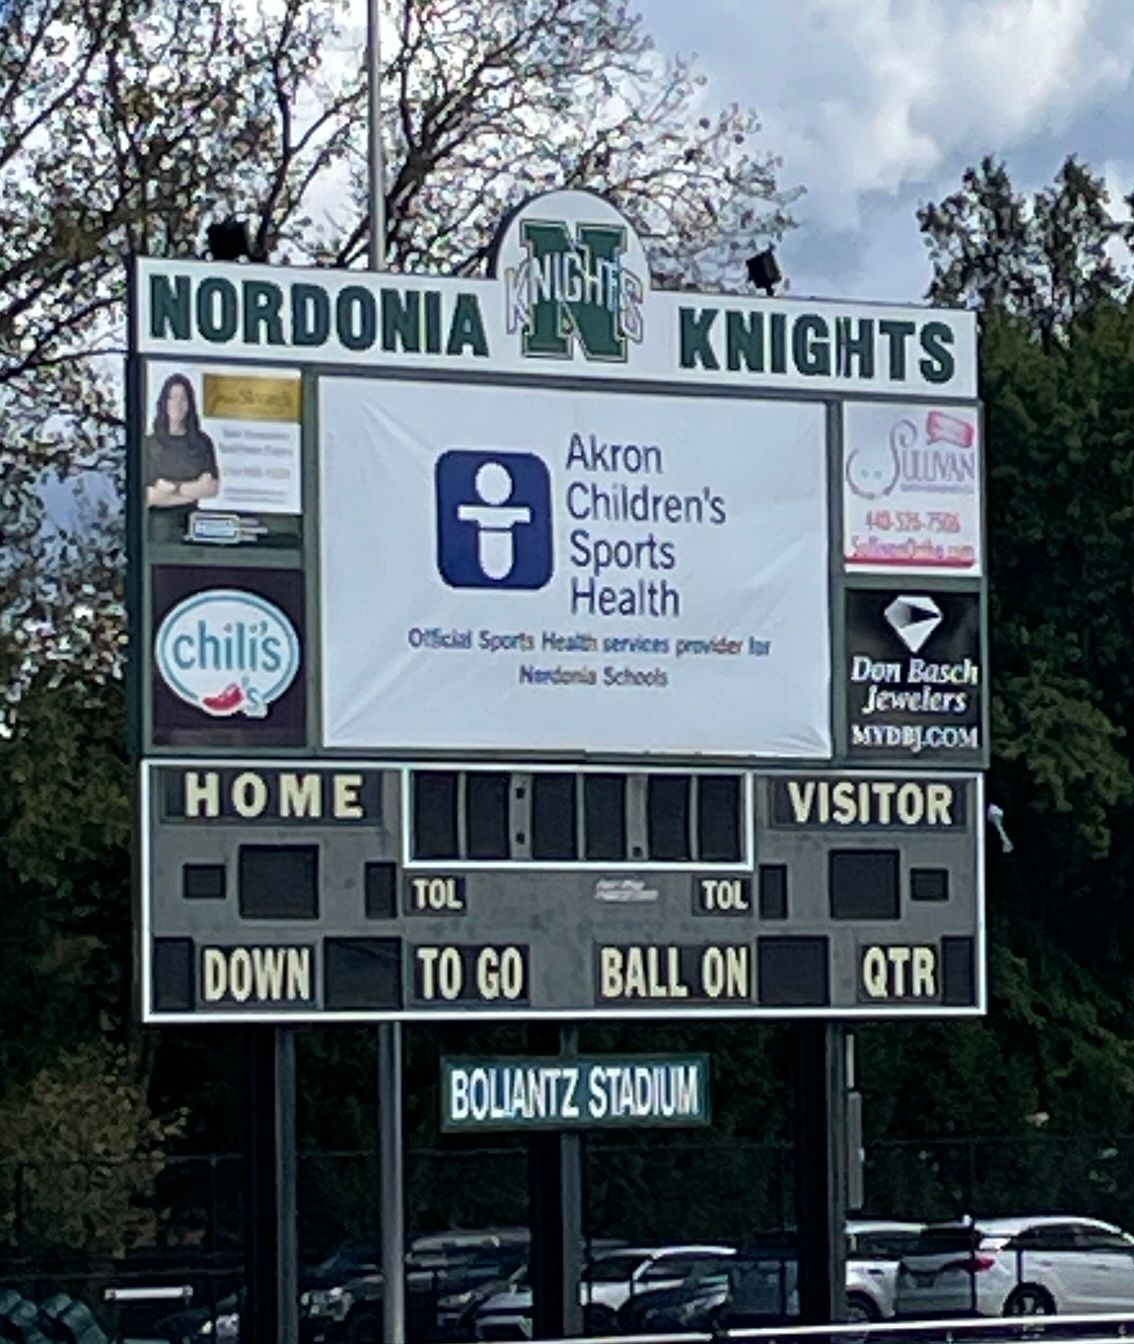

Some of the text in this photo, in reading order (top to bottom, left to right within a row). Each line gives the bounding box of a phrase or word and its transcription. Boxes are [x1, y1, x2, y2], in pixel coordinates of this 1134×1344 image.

[149, 273, 490, 357] NORDONIA
[504, 250, 643, 345] KNIGHTS
[678, 306, 955, 384] KNIGHTS
[565, 433, 663, 474] Akron
[566, 481, 727, 525] Children's
[569, 528, 677, 577] Sports
[570, 576, 680, 618] Health
[172, 620, 282, 672] chili's
[408, 628, 772, 659] Official Sports Health services provider for
[518, 665, 669, 689] Nordonia Schools
[851, 655, 979, 686] Don Basch
[861, 684, 968, 715] Jewelers
[851, 724, 980, 754] MYDBJ.COM
[184, 772, 363, 819] HOME
[787, 781, 954, 826] VISITOR
[412, 878, 464, 909] TOL
[701, 879, 750, 911] TOL
[203, 948, 311, 1003] DOWN
[417, 947, 524, 1001] TO GO
[601, 946, 749, 1000] BALL ON
[862, 946, 936, 999] QTR
[451, 1064, 698, 1120] BOLIANTZ STADIUM
